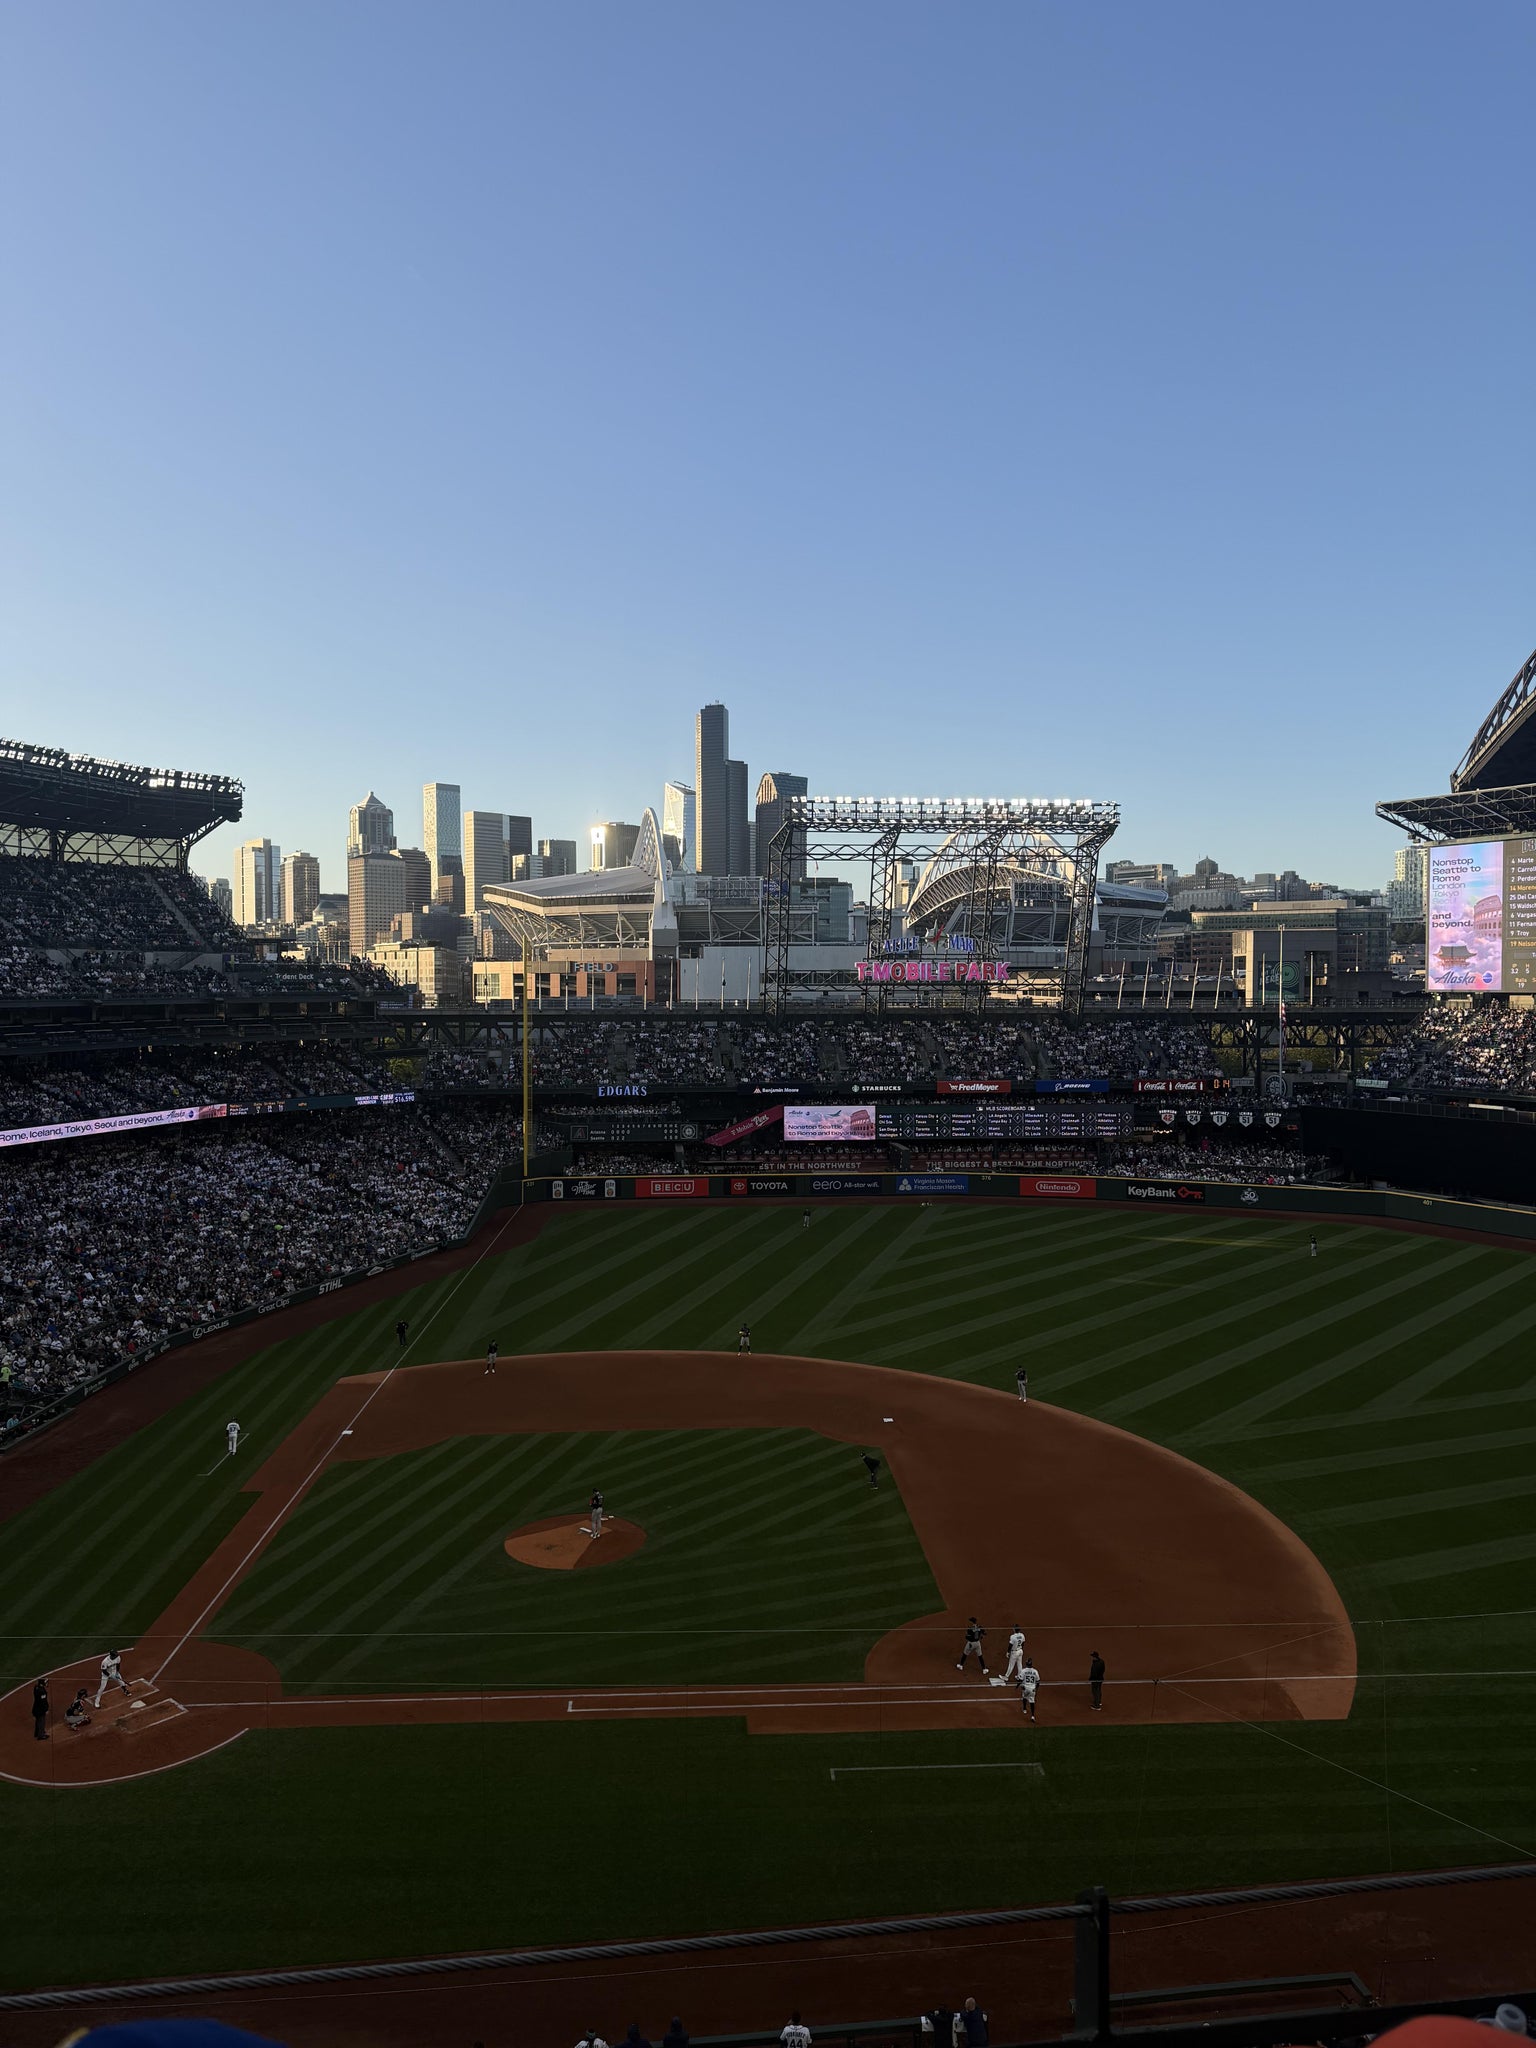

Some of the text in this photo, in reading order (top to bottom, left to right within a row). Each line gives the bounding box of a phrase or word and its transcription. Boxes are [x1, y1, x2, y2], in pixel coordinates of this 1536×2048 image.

[1432, 858, 1474, 866] Nonstop
[1432, 867, 1468, 875] Seattle
[1432, 882, 1466, 890] London
[1432, 890, 1460, 898] Tokyo
[1432, 912, 1452, 920] and
[1432, 920, 1474, 929] beyond.
[574, 962, 614, 972] FIELD
[855, 961, 1012, 981] T-MOBILE PARK
[275, 972, 298, 980] Trdent
[1434, 970, 1476, 986] Alaska
[597, 1085, 649, 1097] EDGARS
[28, 1126, 63, 1140] Iceland,
[64, 1123, 94, 1136] Tokyo,
[94, 1120, 118, 1130] Seoul
[118, 1117, 133, 1128] and
[134, 1114, 164, 1126] beyond.
[777, 1162, 862, 1170] IN THE NORTHWEST
[654, 1183, 692, 1192] BECU
[750, 1182, 788, 1190] TOYOTA
[812, 1180, 842, 1190] eero
[1039, 1182, 1076, 1191] Nintendo
[1127, 1186, 1176, 1198] KeyBank
[318, 1278, 344, 1296] STIHL
[258, 1298, 291, 1314] Great Clips
[203, 1320, 230, 1334] LEXUS
[1026, 1676, 1035, 1684] 53
[790, 2038, 803, 2048] 44
